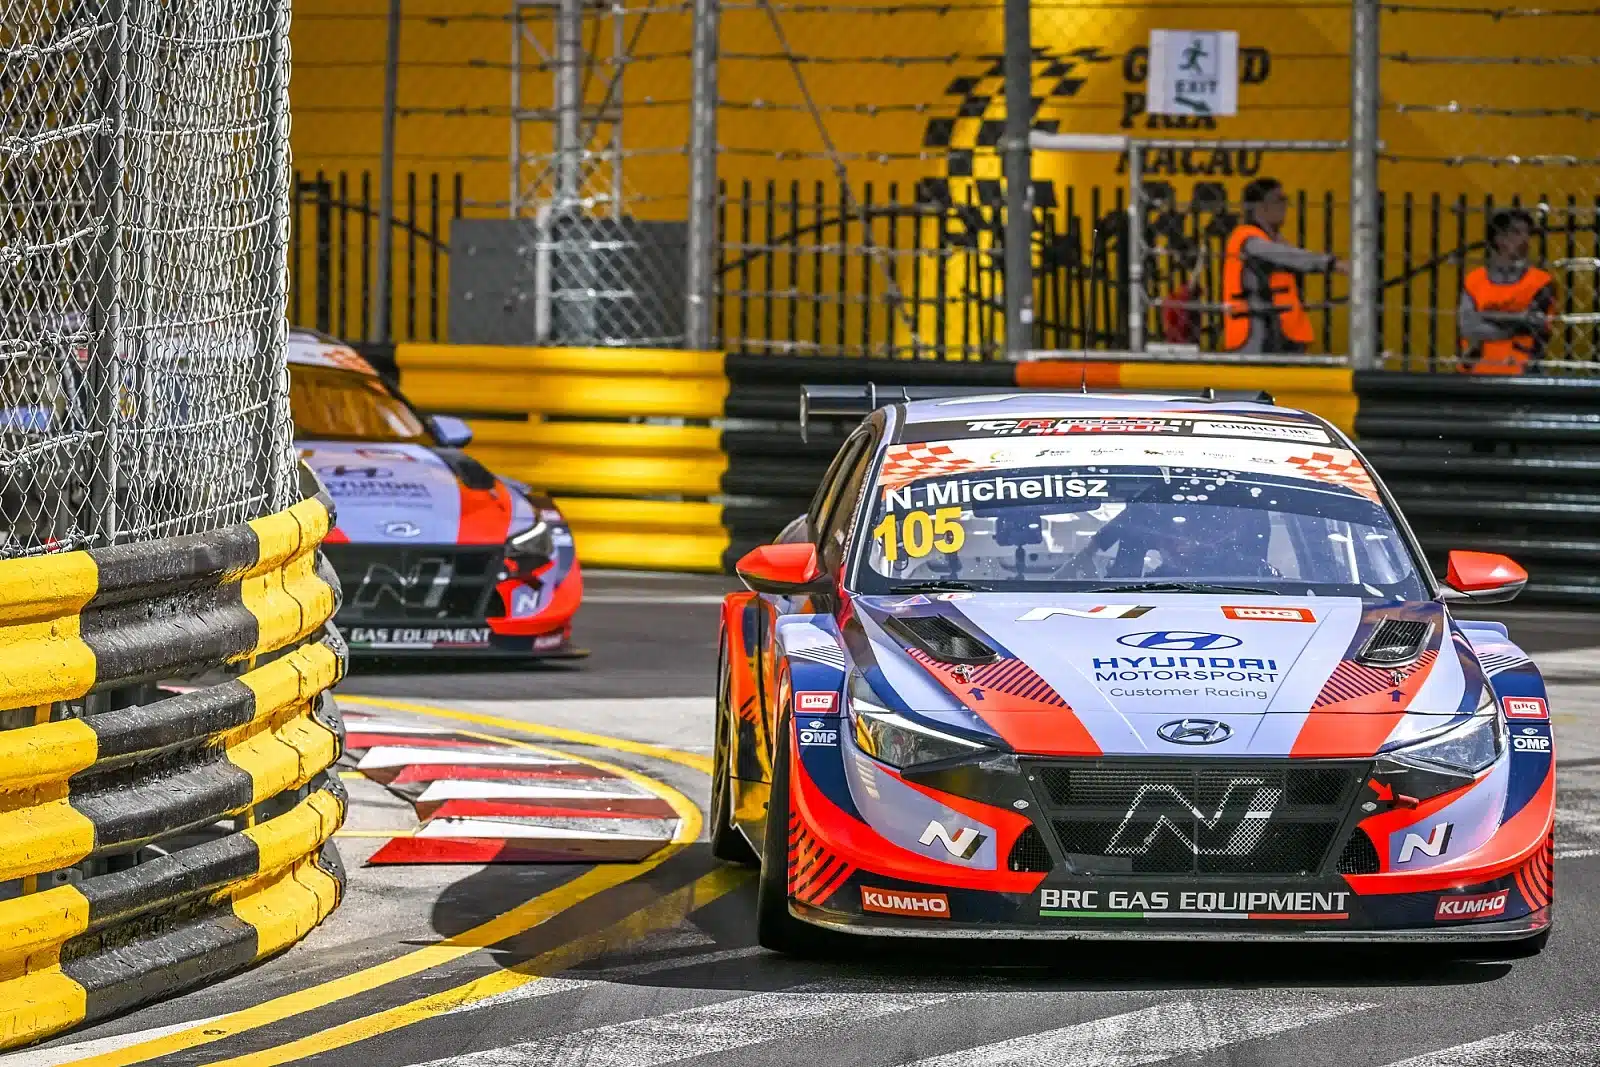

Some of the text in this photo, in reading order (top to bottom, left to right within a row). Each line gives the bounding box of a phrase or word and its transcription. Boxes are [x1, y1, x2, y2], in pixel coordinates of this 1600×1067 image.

[1174, 79, 1217, 93] EXIT
[1080, 424, 1180, 433] TOUR
[1210, 422, 1277, 433] KUMHO
[1279, 427, 1316, 436] TIRE
[885, 475, 1109, 512] N.Michelisz
[873, 507, 965, 561] 105
[351, 627, 389, 643] GAS
[391, 627, 491, 643] EQUIPMENT
[1092, 656, 1278, 671] HYUNDAI
[1095, 671, 1279, 683] MOTORSPORT
[805, 696, 829, 704] BRC
[1110, 687, 1268, 700] Customer Racing
[1513, 703, 1537, 711] BRC
[800, 732, 837, 743] OMP
[1513, 738, 1550, 750] OMP
[864, 891, 947, 913] KUMHO
[1040, 889, 1350, 912] BRC GAS EQUIPMENT
[1438, 895, 1505, 914] KUMHO
